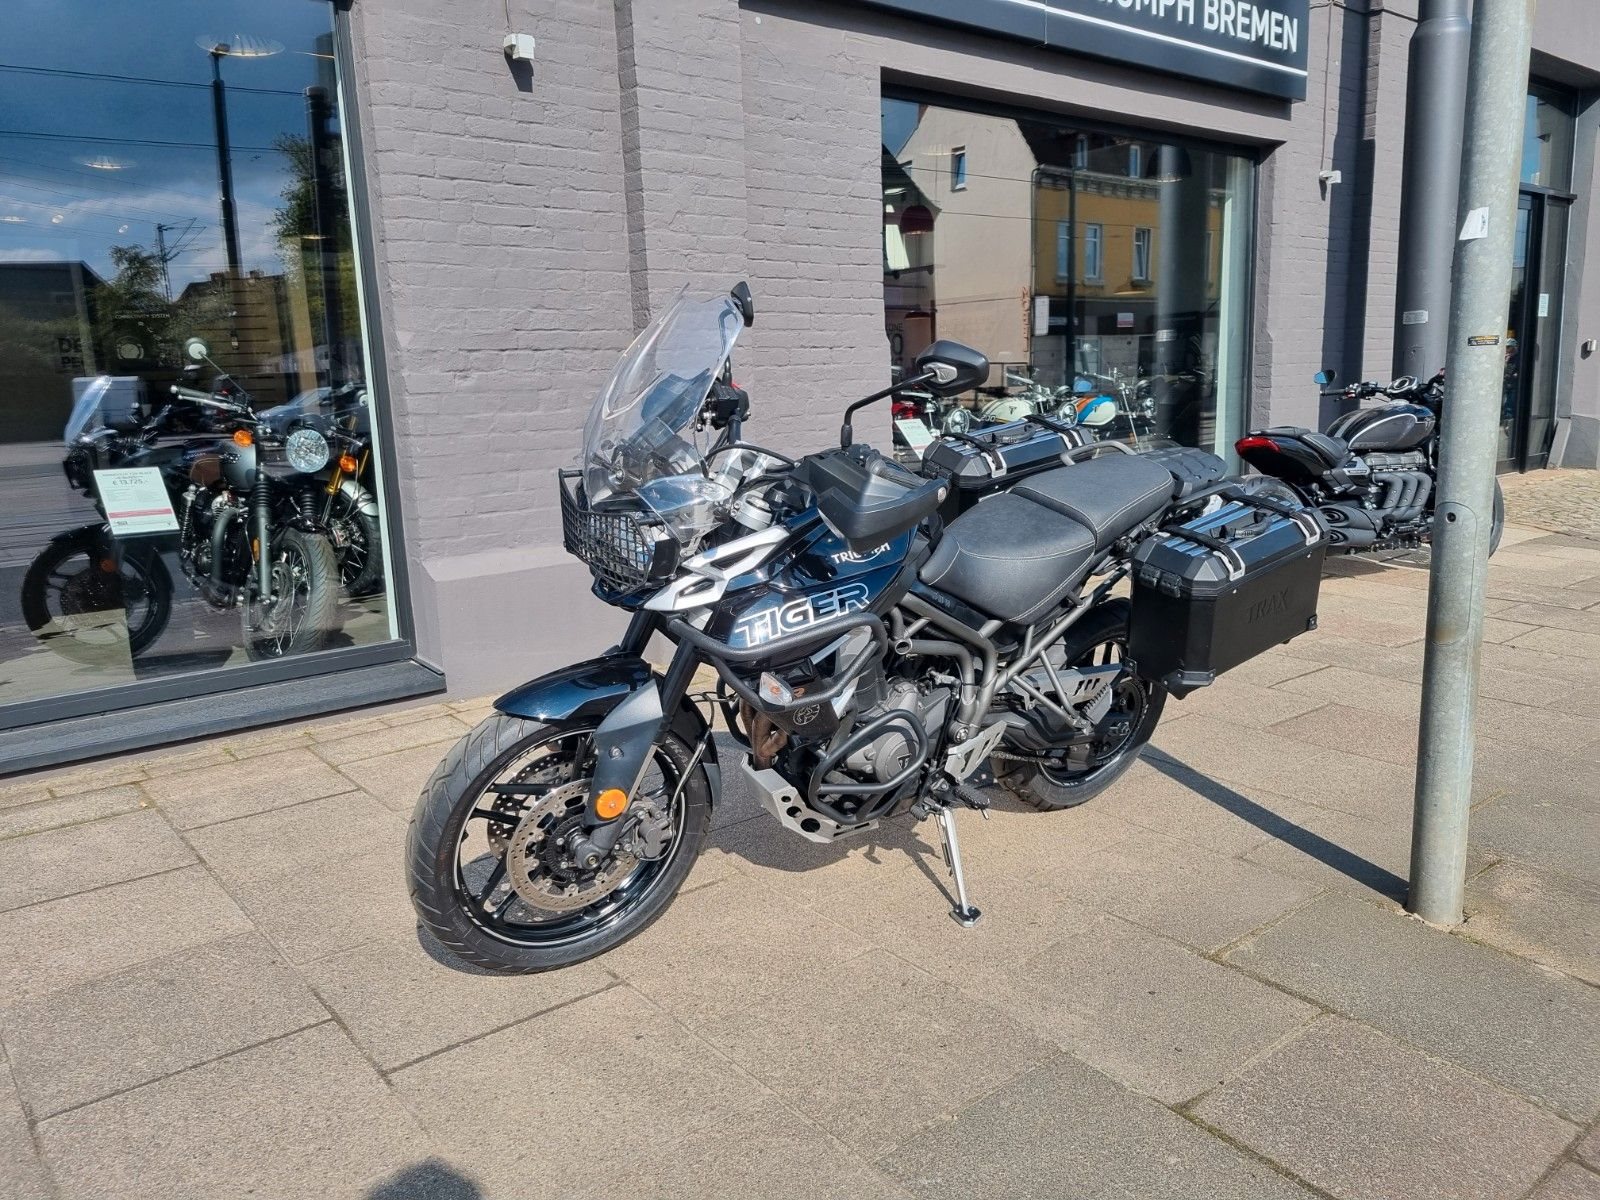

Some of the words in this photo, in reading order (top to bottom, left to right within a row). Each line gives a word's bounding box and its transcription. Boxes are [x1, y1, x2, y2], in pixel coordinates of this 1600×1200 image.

[1204, 0, 1298, 53] BREMEN
[734, 582, 870, 648] TIGER
[1247, 587, 1289, 624] TRAX
